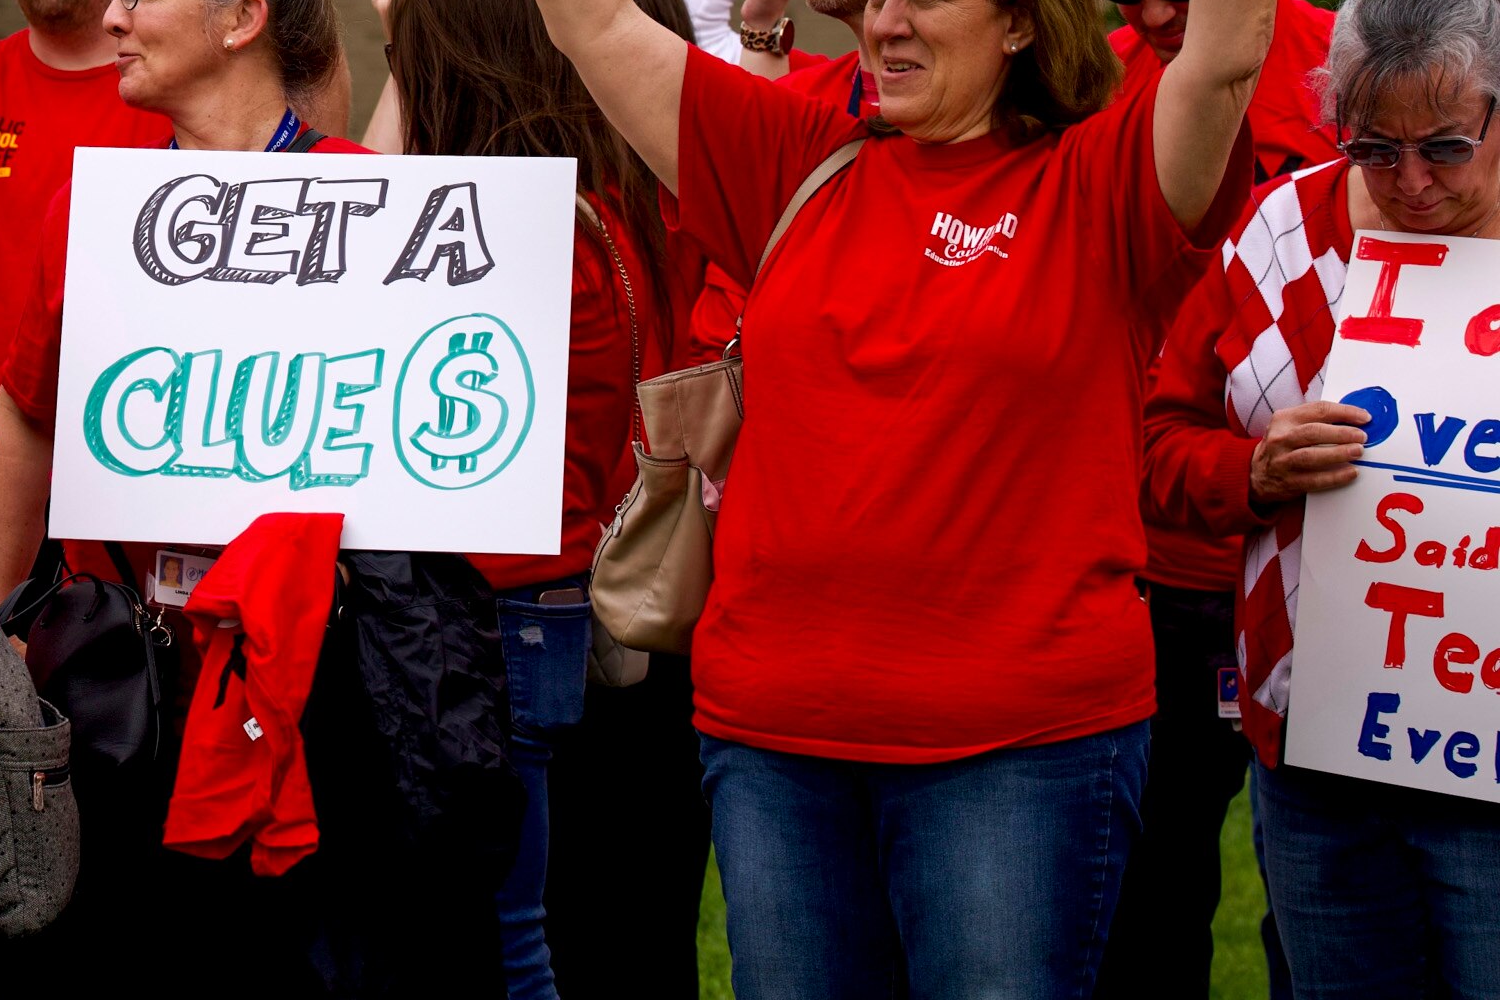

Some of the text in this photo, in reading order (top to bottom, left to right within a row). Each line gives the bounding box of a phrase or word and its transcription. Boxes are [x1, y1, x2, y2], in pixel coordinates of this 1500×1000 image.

[269, 129, 290, 152] POWER
[133, 174, 495, 286] GET A
[1339, 236, 1449, 348] I
[83, 346, 386, 492] CLUE
[1354, 492, 1500, 570] Said
